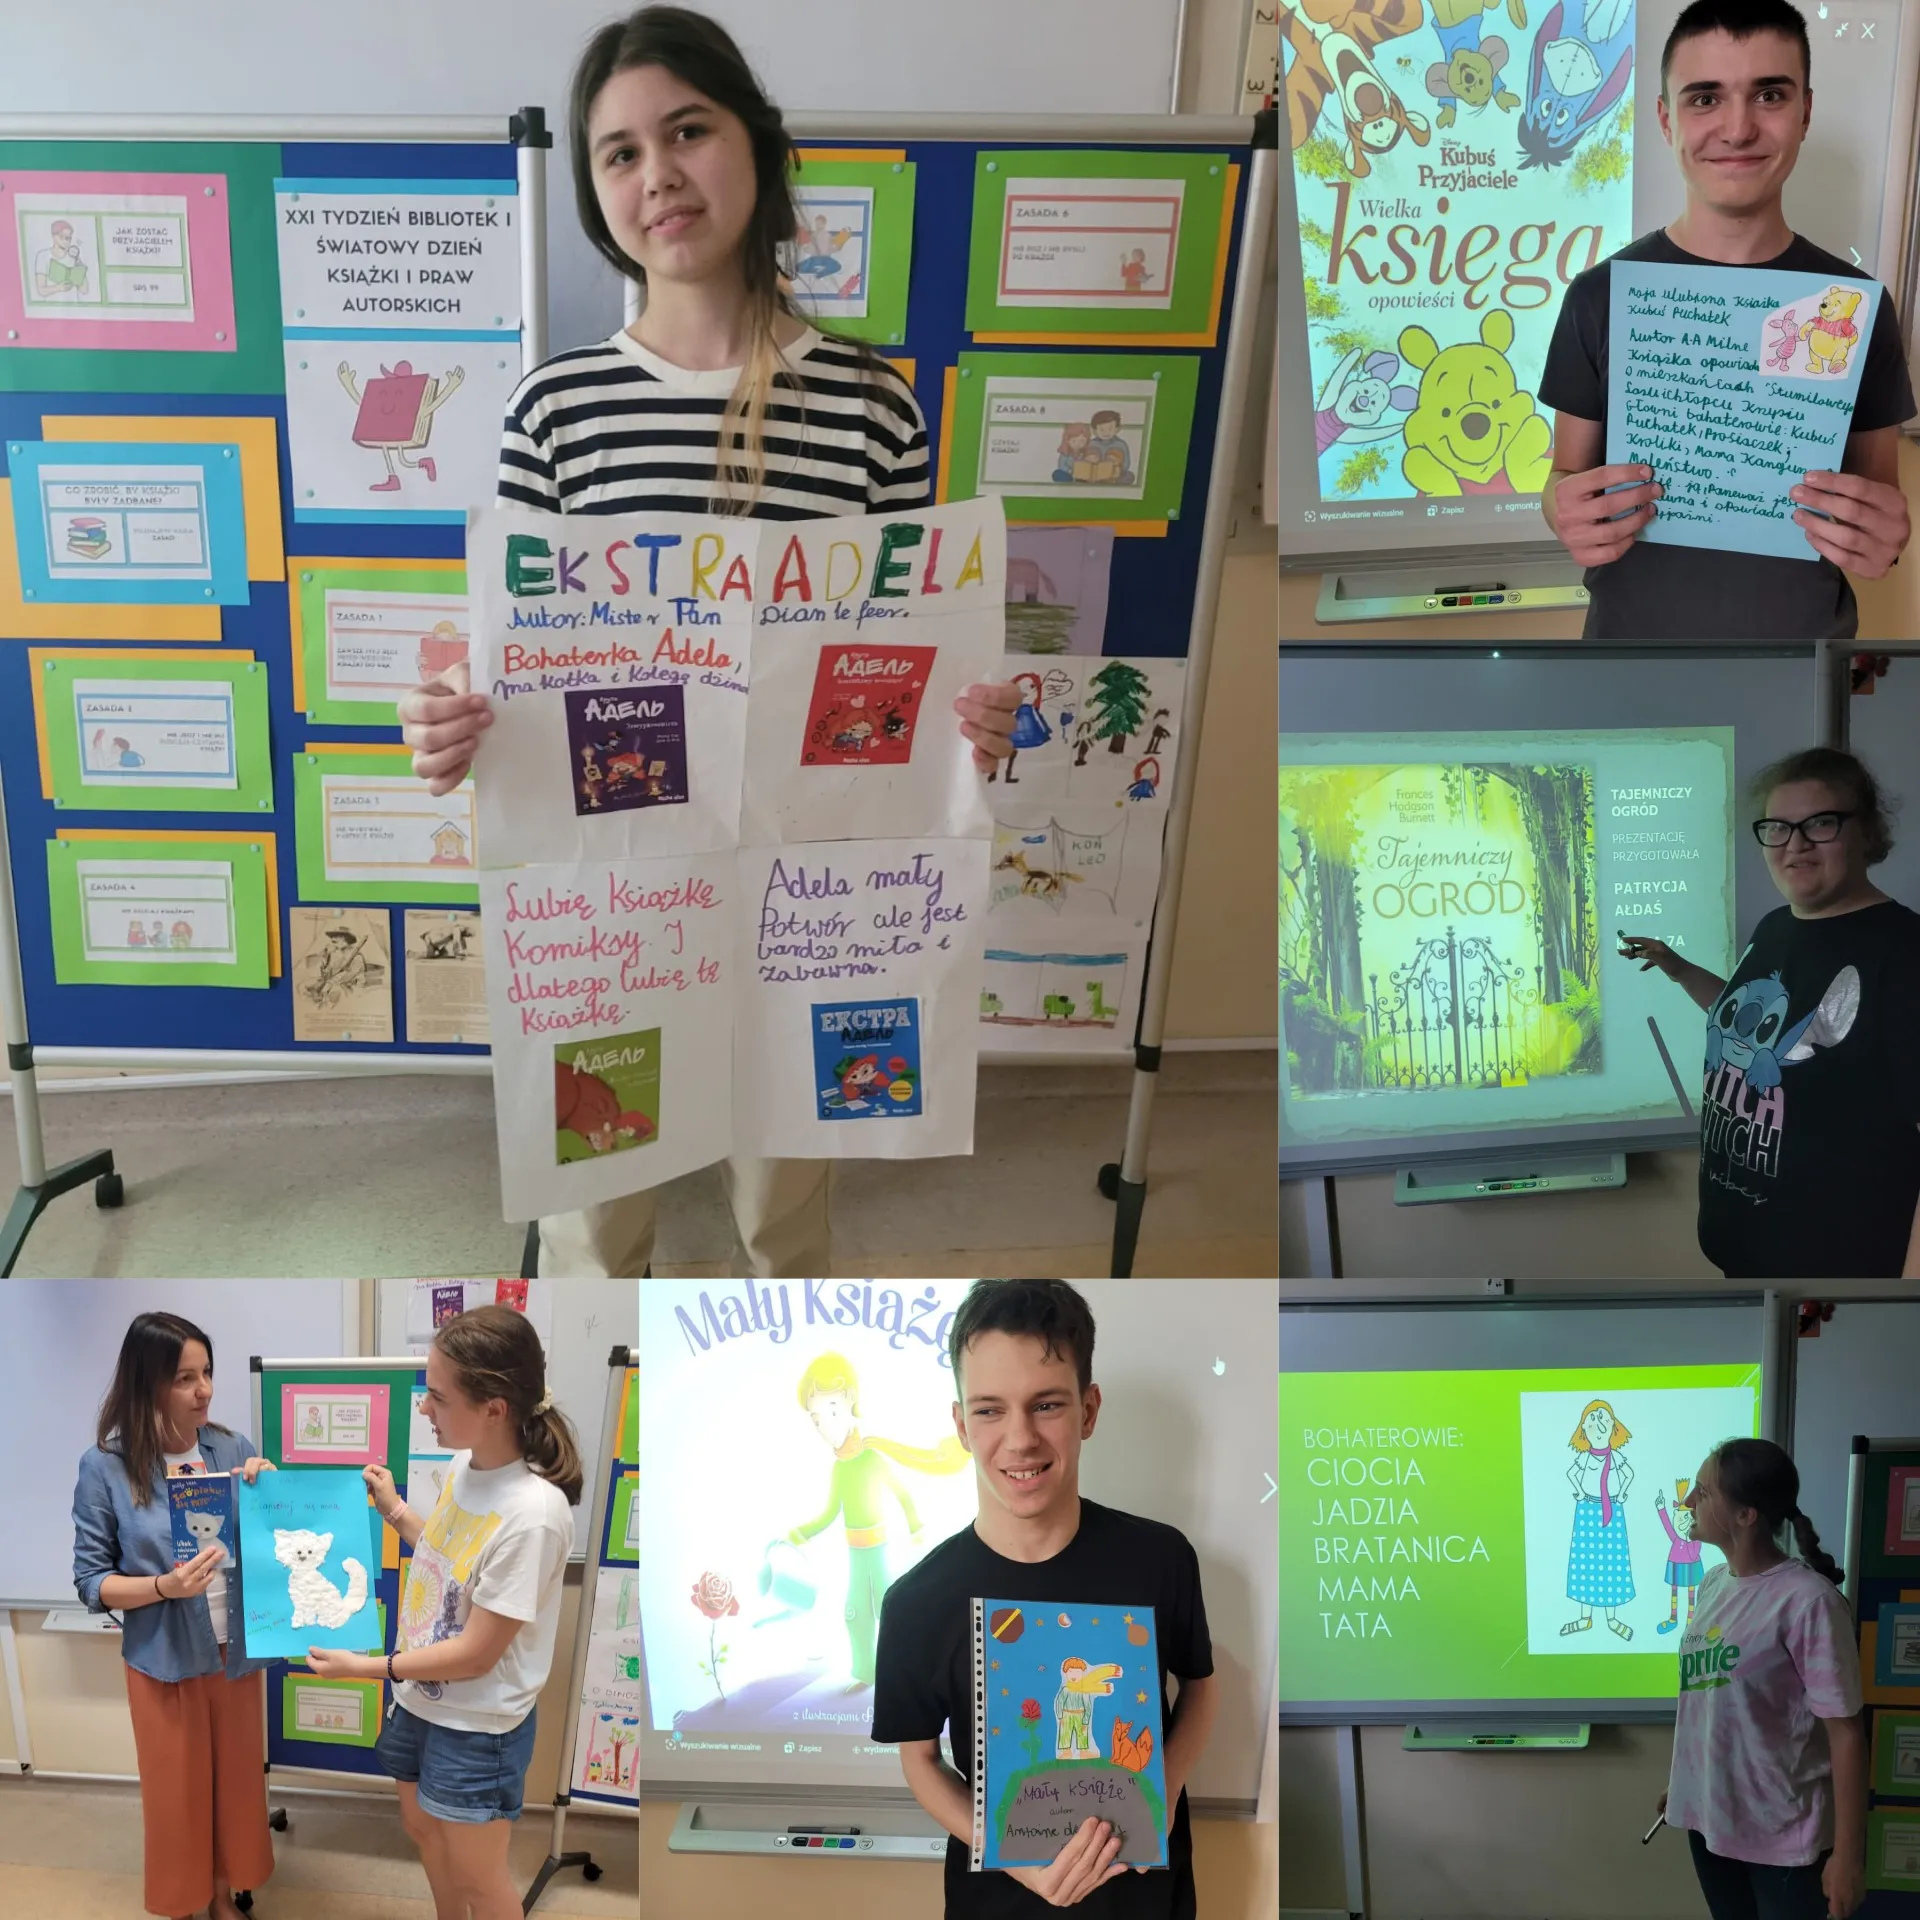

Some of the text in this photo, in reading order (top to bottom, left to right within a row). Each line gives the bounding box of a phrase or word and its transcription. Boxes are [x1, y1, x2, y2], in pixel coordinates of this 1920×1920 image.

[1440, 145, 1496, 167] Kubuś
[1418, 165, 1519, 192] Przyjaciele
[286, 205, 511, 228] XXI TYDZIEŃ BIBLIOTEK I
[1016, 209, 1058, 217] ZASADA
[1359, 199, 1422, 219] Wielka
[316, 236, 482, 256] ŚWIATOWY DZIEŃ
[1326, 182, 1604, 311] księga
[327, 265, 475, 287] KSIĄŻKI I PRAW
[342, 298, 461, 314] AUTORSKICH
[1368, 291, 1455, 313] opowieści
[1662, 288, 1726, 306] ulubiona
[1706, 335, 1749, 352] Milne
[996, 405, 1036, 413] ZASADA
[1791, 425, 1837, 445] Kubuś
[1695, 446, 1735, 463] Mama
[1320, 508, 1404, 521] Wyszukiwanie wizualne
[1441, 506, 1465, 515] Zapisz
[336, 613, 375, 621] ZASADA
[507, 605, 586, 629] Autor:
[504, 642, 641, 675] Bohaterka
[833, 653, 914, 677] АДЕЛЬ
[493, 680, 536, 700] ma
[611, 669, 620, 682] i
[584, 698, 664, 722] АДЕЛЬ
[1396, 789, 1434, 800] Frances
[1611, 787, 1692, 800] TAJEMNICZY
[1389, 801, 1435, 813] Hodgson
[1611, 802, 1658, 817] OGRÓD
[1399, 813, 1435, 823] Burnett
[1612, 831, 1686, 844] PREZENTACJĘ
[1377, 835, 1513, 889] Tajemniczy
[1613, 849, 1700, 862] PRZYGOTOWAŁA
[764, 853, 944, 906] Adela mały
[1614, 880, 1688, 895] PATRYCJA
[1372, 871, 1526, 919] OGRÓD
[873, 904, 913, 929] ale
[921, 903, 968, 934] jest
[1615, 900, 1662, 917] AŁDAŚ
[937, 934, 950, 950] i
[821, 1006, 911, 1032] ЕКСТРА
[572, 1047, 646, 1075] АДЕЛЬ
[674, 1278, 792, 1357] Mały
[1304, 1427, 1465, 1449] BOHATEROWIE:
[1307, 1457, 1426, 1487] CIOCIA
[1312, 1498, 1419, 1526] JADZIA
[1314, 1535, 1491, 1564] BRATANICA
[1319, 1577, 1421, 1602] MAMA
[1319, 1612, 1393, 1639] TATA
[1681, 1637, 1740, 1691] prite
[802, 1707, 859, 1723] ilustracjami
[680, 1741, 761, 1751] Wyszukiwanie wizualne
[799, 1745, 822, 1753] Zapisz
